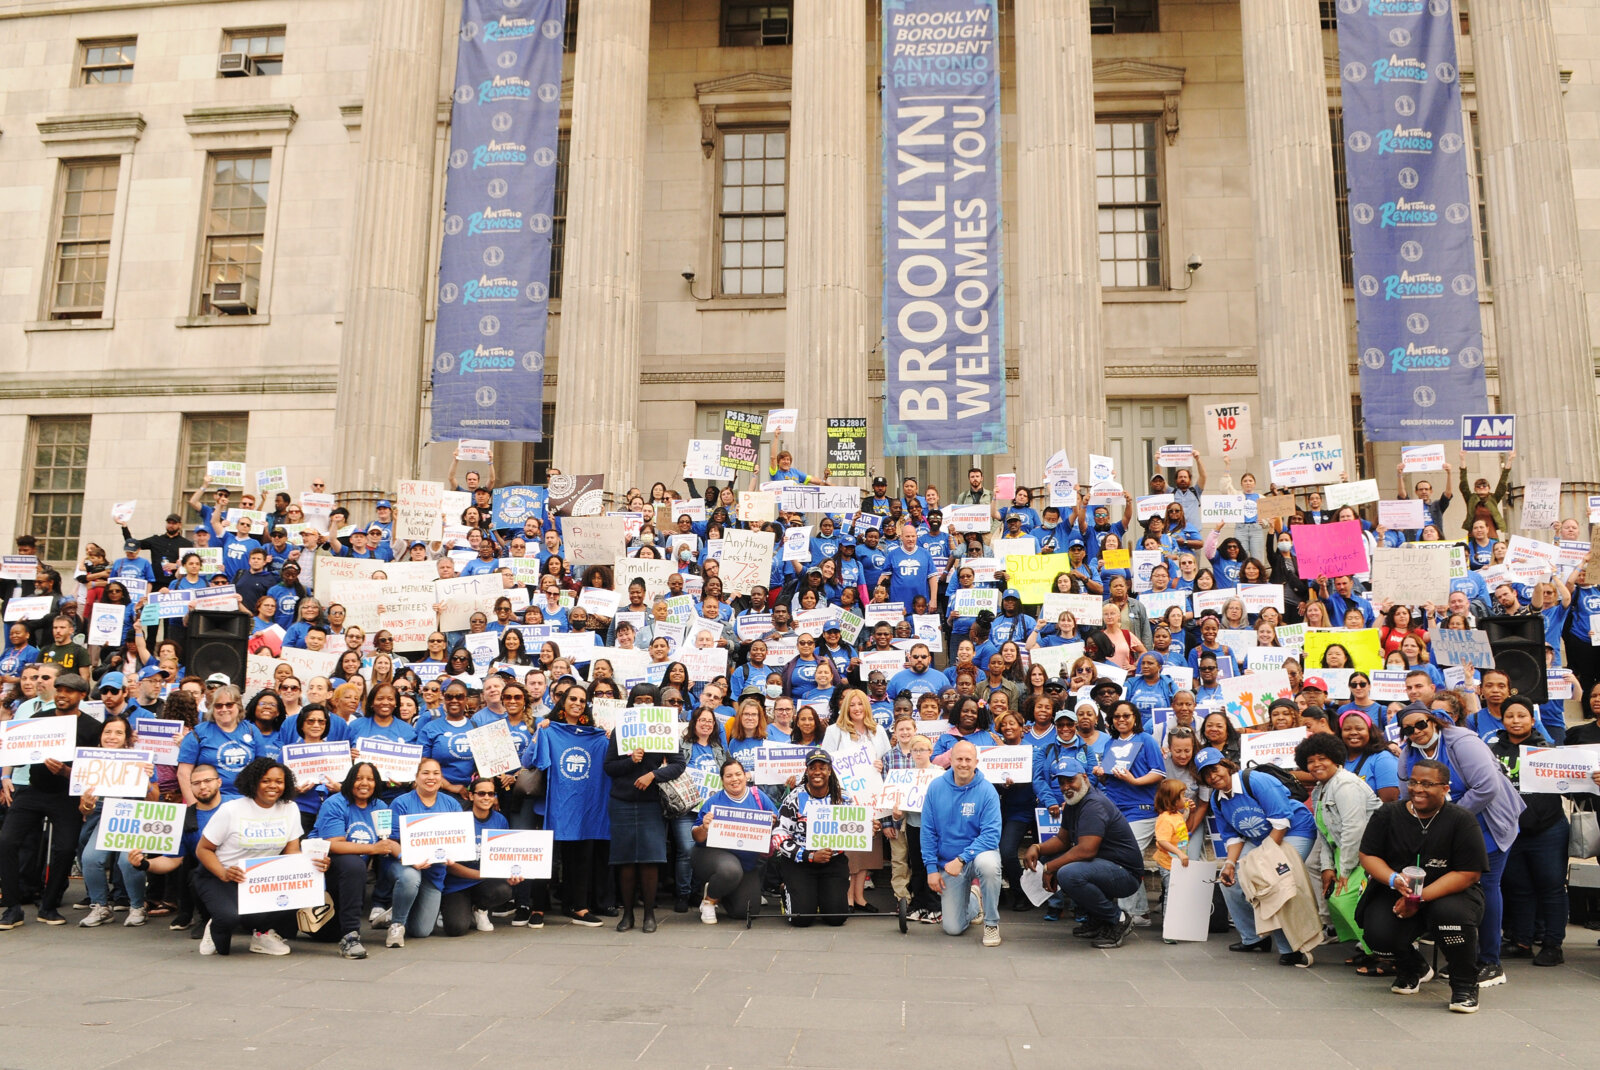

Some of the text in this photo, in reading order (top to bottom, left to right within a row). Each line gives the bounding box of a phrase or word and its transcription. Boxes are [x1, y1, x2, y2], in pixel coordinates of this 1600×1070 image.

[893, 9, 990, 26] BROOKLYN
[896, 25, 987, 41] BOROUGH
[894, 40, 991, 56] PRESIDENT
[893, 56, 988, 72] ANTONIO
[895, 72, 988, 88] REYNOSO
[897, 106, 948, 420] BROOKLYN
[953, 106, 990, 420] WELCOMES YOU
[727, 411, 738, 420] PS
[1215, 406, 1240, 416] VOTE
[1218, 417, 1236, 431] NO
[1463, 419, 1512, 436] I AM
[731, 436, 752, 447] FAIR
[838, 442, 856, 450] FAIR
[1299, 441, 1323, 450] FAIR
[1464, 439, 1512, 448] THE UNION
[724, 445, 755, 455] CONTRACT
[728, 452, 757, 463] NOW!
[1403, 456, 1444, 464] COMMITMENT
[265, 468, 282, 476] FUND
[704, 465, 730, 477] BLUE
[512, 488, 538, 500] DESERVE
[1214, 501, 1231, 509] FAIR
[408, 527, 430, 539] NOW!
[725, 531, 768, 555] Anything
[228, 550, 242, 560] UFT
[723, 552, 763, 562] Less than
[1317, 550, 1359, 564] Contract
[321, 558, 360, 569] Smaller
[513, 558, 535, 568] FUND
[619, 560, 660, 573] Smaller
[1007, 555, 1050, 573] STOP
[330, 569, 354, 578] Class
[901, 567, 918, 576] UFT
[443, 583, 469, 595] UFT
[1457, 588, 1472, 596] UFT
[157, 593, 182, 601] FAIR
[971, 591, 993, 599] FUND
[386, 604, 428, 613] RETIREES
[585, 599, 610, 607] EXPERTISE
[841, 610, 861, 626] FUND
[382, 620, 404, 628] HANDS
[802, 620, 827, 628] EXPERTISE
[997, 632, 1011, 641] UFT
[1439, 630, 1474, 642] FAIR
[1433, 641, 1485, 653] CONTRACT
[1263, 654, 1284, 663] FAIR
[1448, 651, 1491, 665] NOW!
[414, 666, 440, 674] FAIR
[803, 666, 818, 677] UFT
[1135, 702, 1156, 710] UFT
[639, 708, 672, 723] FUND
[621, 723, 646, 738] OUR
[6, 739, 67, 750] COMMITMENT
[364, 740, 392, 751] THE TIME
[621, 736, 674, 752] SCHOOLS
[289, 746, 321, 756] THE TIME
[225, 756, 246, 766] UFT
[301, 759, 328, 768] MEMBERS
[830, 745, 872, 776] Respect
[986, 762, 1023, 770] EXPERTISE
[75, 760, 145, 787] #BKUFT
[303, 765, 345, 774] FAIR CONTRACT
[490, 761, 510, 775] NOW
[566, 764, 584, 773] UFT
[1535, 768, 1587, 779] EXPERTISE
[888, 768, 933, 786] Kids for
[842, 775, 866, 792] For
[880, 785, 905, 806] Fair
[134, 802, 176, 822] FUND
[730, 811, 745, 819] TIME
[754, 814, 772, 822] NOW!
[832, 806, 866, 822] FUND
[108, 817, 141, 834] OUR
[813, 821, 839, 834] OUR
[244, 827, 286, 838] GREEN
[104, 833, 174, 852] SCHOOLS
[410, 836, 467, 847] COMMITMENT
[812, 835, 867, 849] SCHOOLS
[489, 853, 543, 862] COMMITMENT
[249, 876, 275, 884] RESPECT
[249, 880, 314, 894] COMMITMENT
